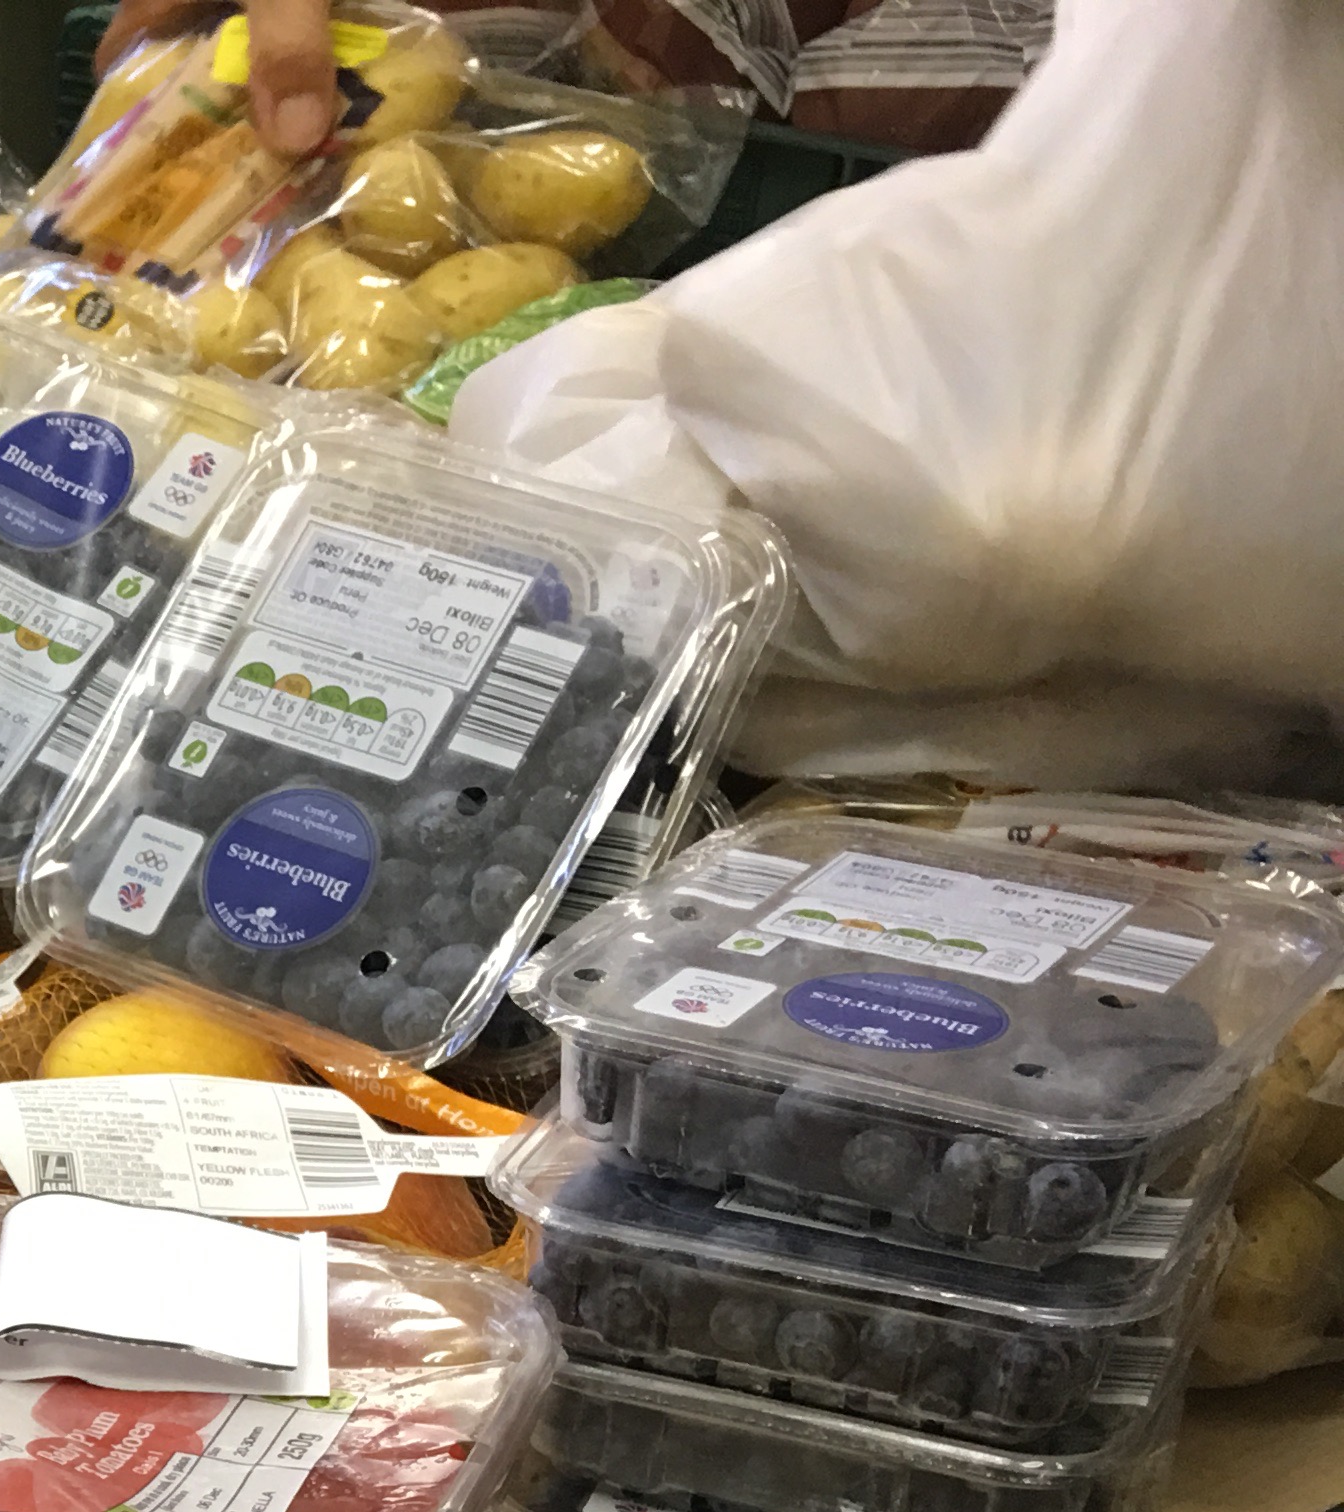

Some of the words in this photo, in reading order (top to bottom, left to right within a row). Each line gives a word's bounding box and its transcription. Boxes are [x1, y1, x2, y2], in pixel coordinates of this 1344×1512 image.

[0, 444, 109, 506] Blueberries
[337, 585, 368, 602] Peru
[402, 615, 450, 645] Dec
[443, 605, 494, 631] Biloxi
[451, 629, 482, 654] 08
[225, 841, 351, 902] Blueberries
[213, 901, 241, 933] FRUIT
[986, 905, 1042, 925] Dec
[241, 927, 304, 942] NATURE'S
[810, 991, 979, 1034] Blueberries
[189, 1124, 231, 1138] SOUTH
[234, 1128, 279, 1142] AFRICA
[193, 1142, 257, 1158] TEMPTATION
[196, 1162, 247, 1177] YELLOW
[249, 1165, 290, 1179] FLESH
[41, 1179, 72, 1193] ALDI
[36, 1439, 93, 1465] Baby
[65, 1408, 120, 1445] Plum
[75, 1420, 156, 1478] Tomatoes
[277, 1430, 323, 1461] 250g
[205, 1483, 223, 1501] Dec
